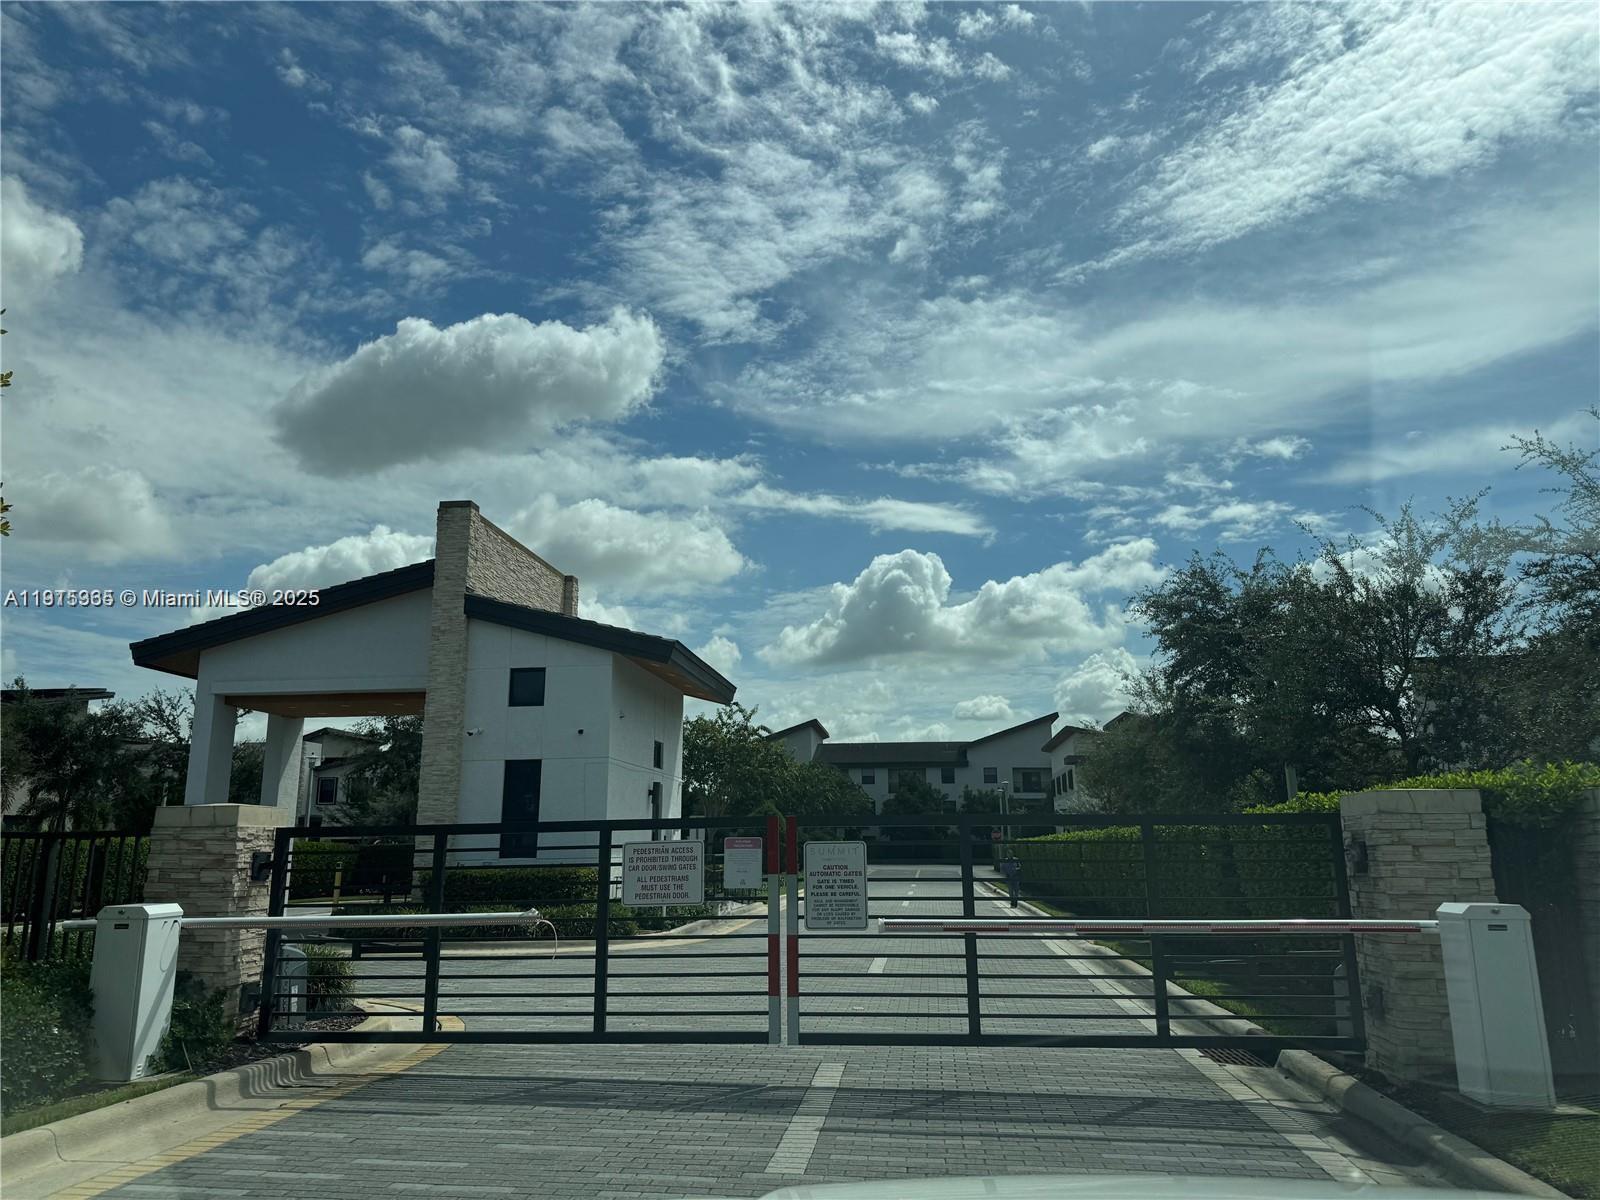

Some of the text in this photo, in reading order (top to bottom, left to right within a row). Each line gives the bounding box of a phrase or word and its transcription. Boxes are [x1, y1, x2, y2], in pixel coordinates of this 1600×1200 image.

[633, 847, 669, 855] PEDESTRIAN
[628, 856, 634, 864] IS
[637, 875, 689, 883] ALL PEDESTRIANS
[634, 892, 671, 900] PEDESTRIAN
